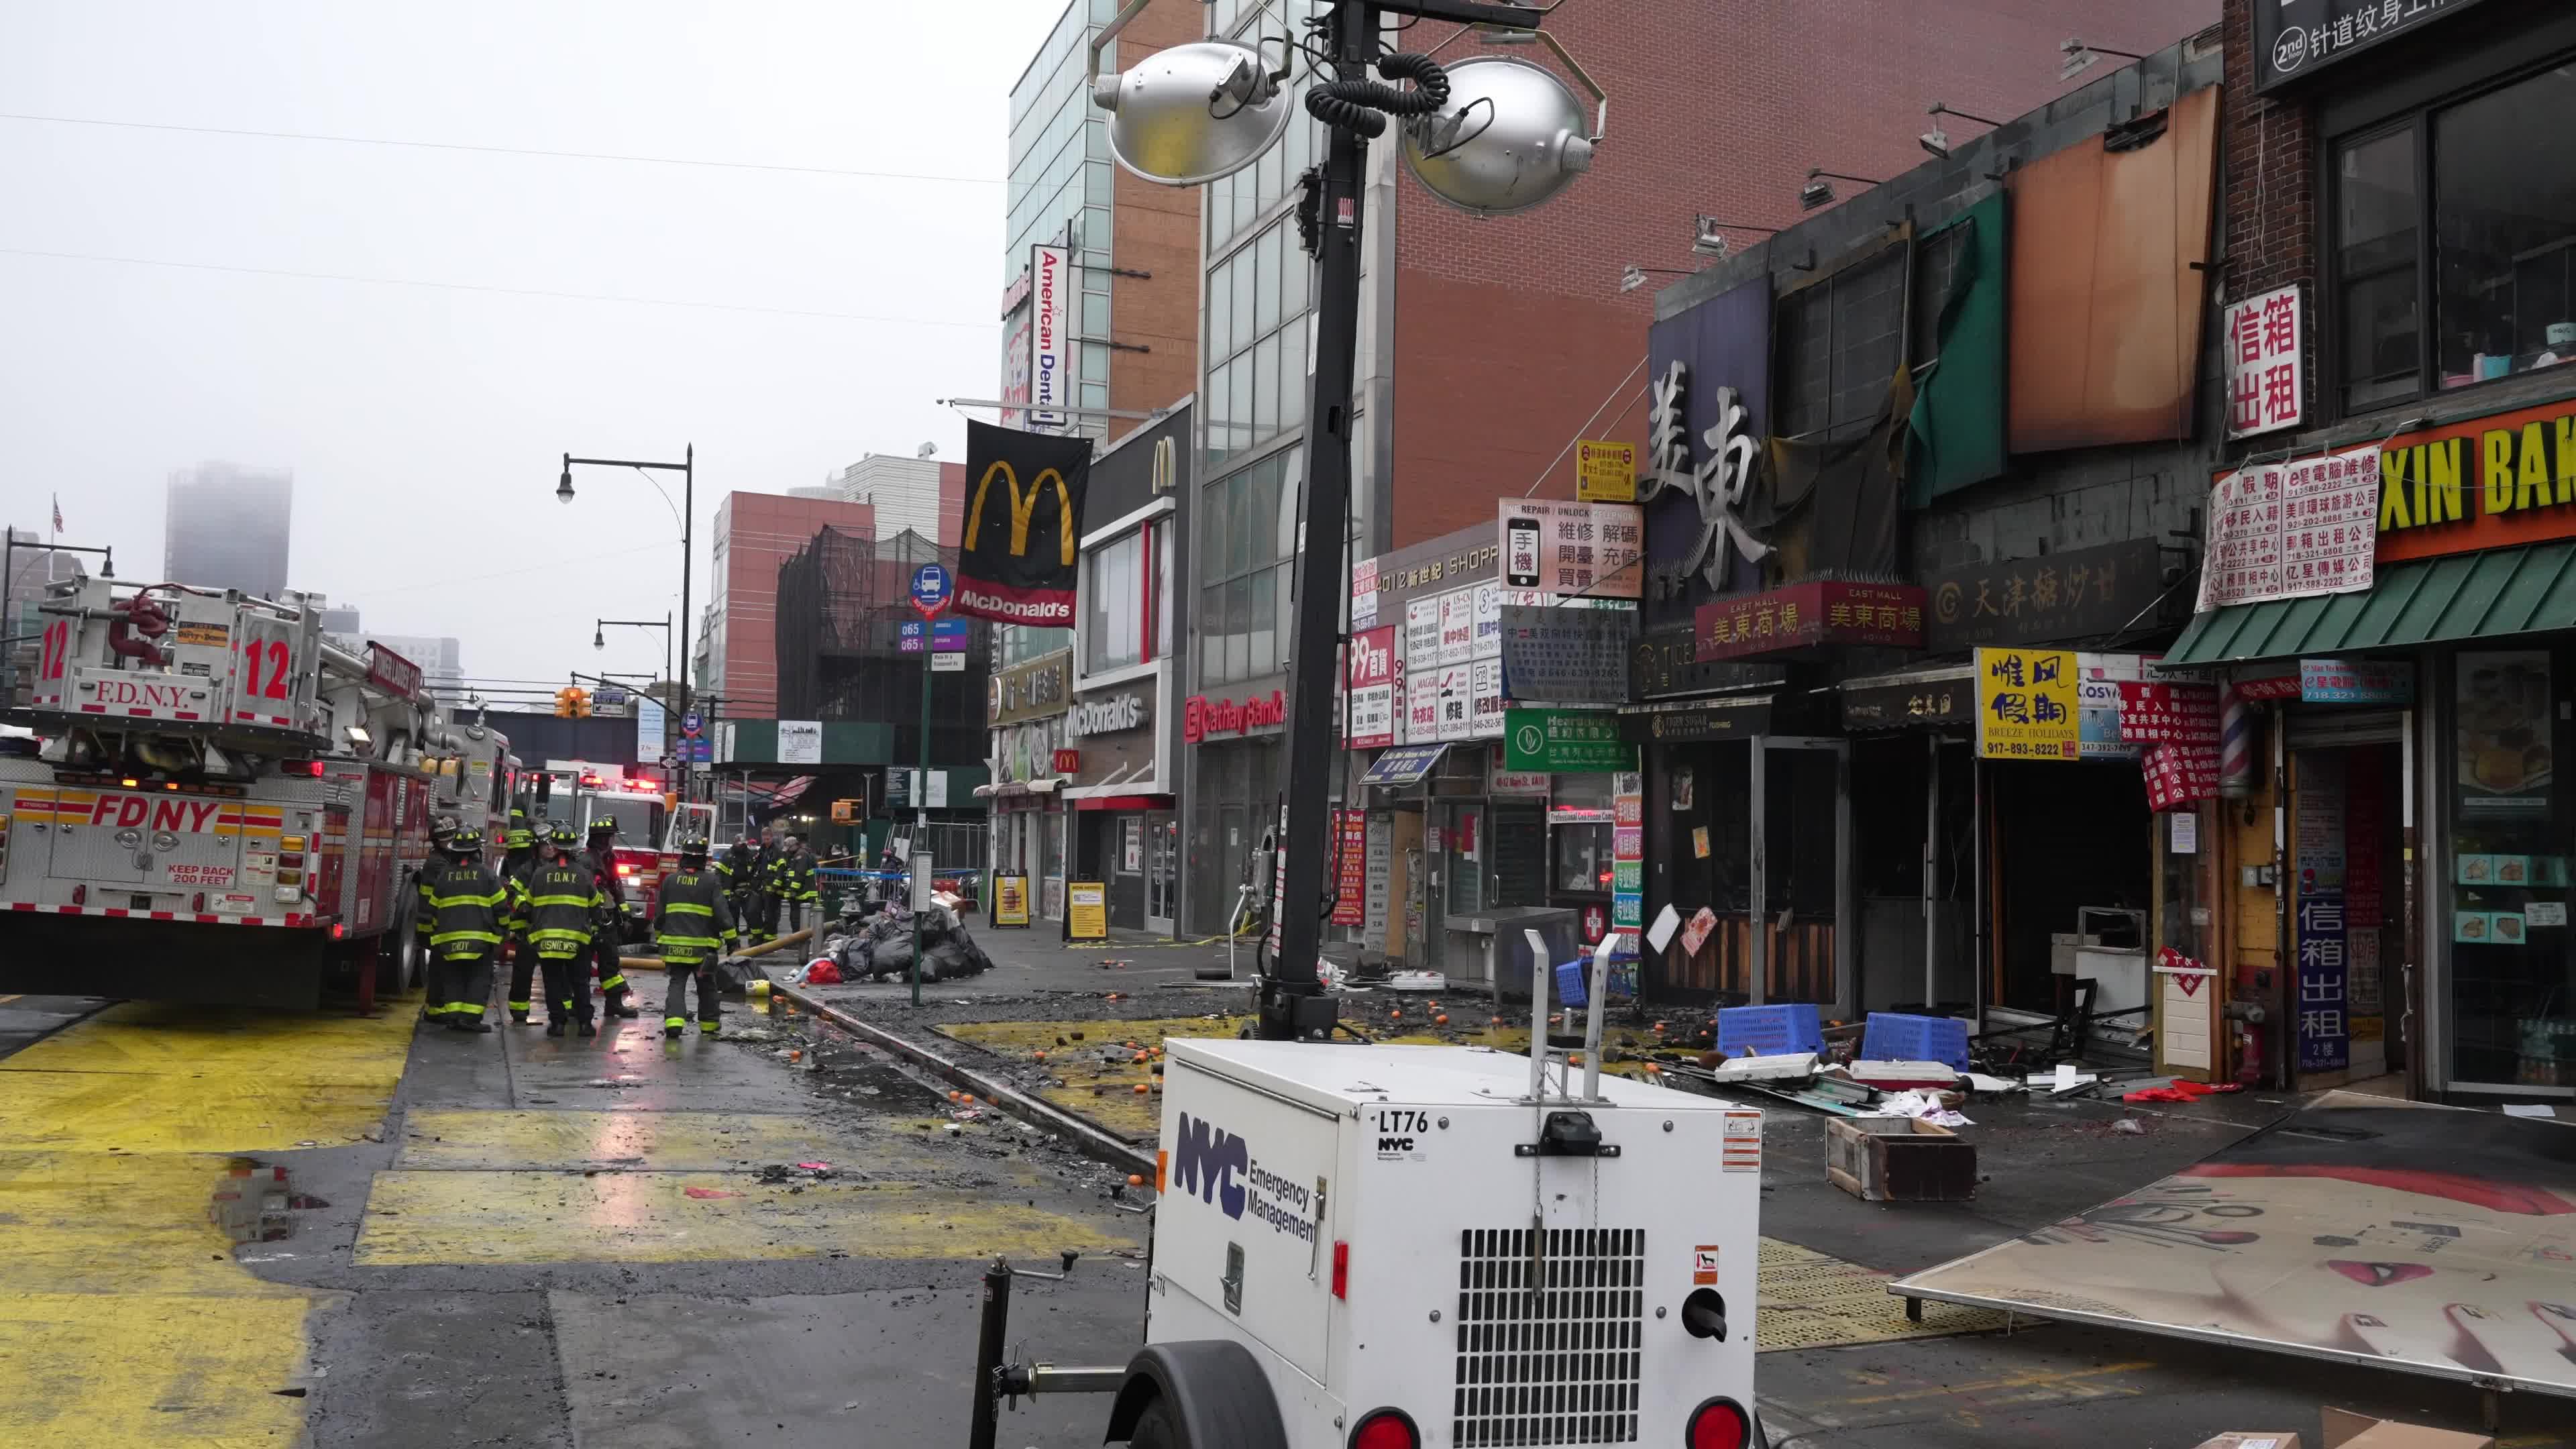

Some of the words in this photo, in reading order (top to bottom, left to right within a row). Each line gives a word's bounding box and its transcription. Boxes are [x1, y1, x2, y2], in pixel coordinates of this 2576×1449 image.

[2277, 34, 2303, 65] 2nd
[1040, 251, 1057, 350] American
[2230, 294, 2296, 366] 信箱
[2232, 362, 2297, 430] 出租
[2379, 436, 2463, 532] XIN
[1521, 505, 1550, 515] REPAIR
[1558, 508, 1590, 518] UNLOCK
[1558, 521, 1595, 542] 維修
[1603, 524, 1638, 545] 解碼
[1514, 531, 1533, 572] 手機
[1603, 547, 1638, 568] 充值
[1376, 571, 1407, 593] 4012
[1448, 545, 1499, 576] SHOPP
[1557, 568, 1594, 588] 買賣
[960, 589, 1070, 618] McDonald's
[1729, 601, 1752, 613] EAST
[1754, 597, 1780, 608] MALL
[1848, 589, 1873, 598] EAST
[1876, 590, 1902, 600] MALL
[1713, 602, 1799, 646] 美東商場
[1829, 601, 1922, 632] 美東商場
[42, 619, 66, 682] 12
[246, 639, 289, 700] 12
[96, 680, 189, 709] F.D.N.Y.
[1246, 690, 1285, 727] Bank
[1990, 692, 2067, 725] 假期
[1065, 692, 1139, 737] McDonald's
[1684, 714, 1707, 726] SUGAR
[1987, 741, 2059, 755] 917-893-8222
[1988, 727, 2024, 739] BREEZE
[2028, 728, 2075, 739] HOLIDAYS
[92, 794, 221, 833] FDNY
[168, 864, 199, 875] KEEP
[202, 865, 235, 877] BACK
[173, 874, 197, 884] 200
[200, 875, 228, 885] FEET
[2299, 901, 2346, 1040] 信箱出租
[1380, 1110, 1428, 1133] LT76
[1378, 1138, 1414, 1151] NYC
[1174, 1111, 1248, 1222] NYC
[1248, 1159, 1309, 1214] Emergency
[1153, 1275, 1166, 1297] LT76
